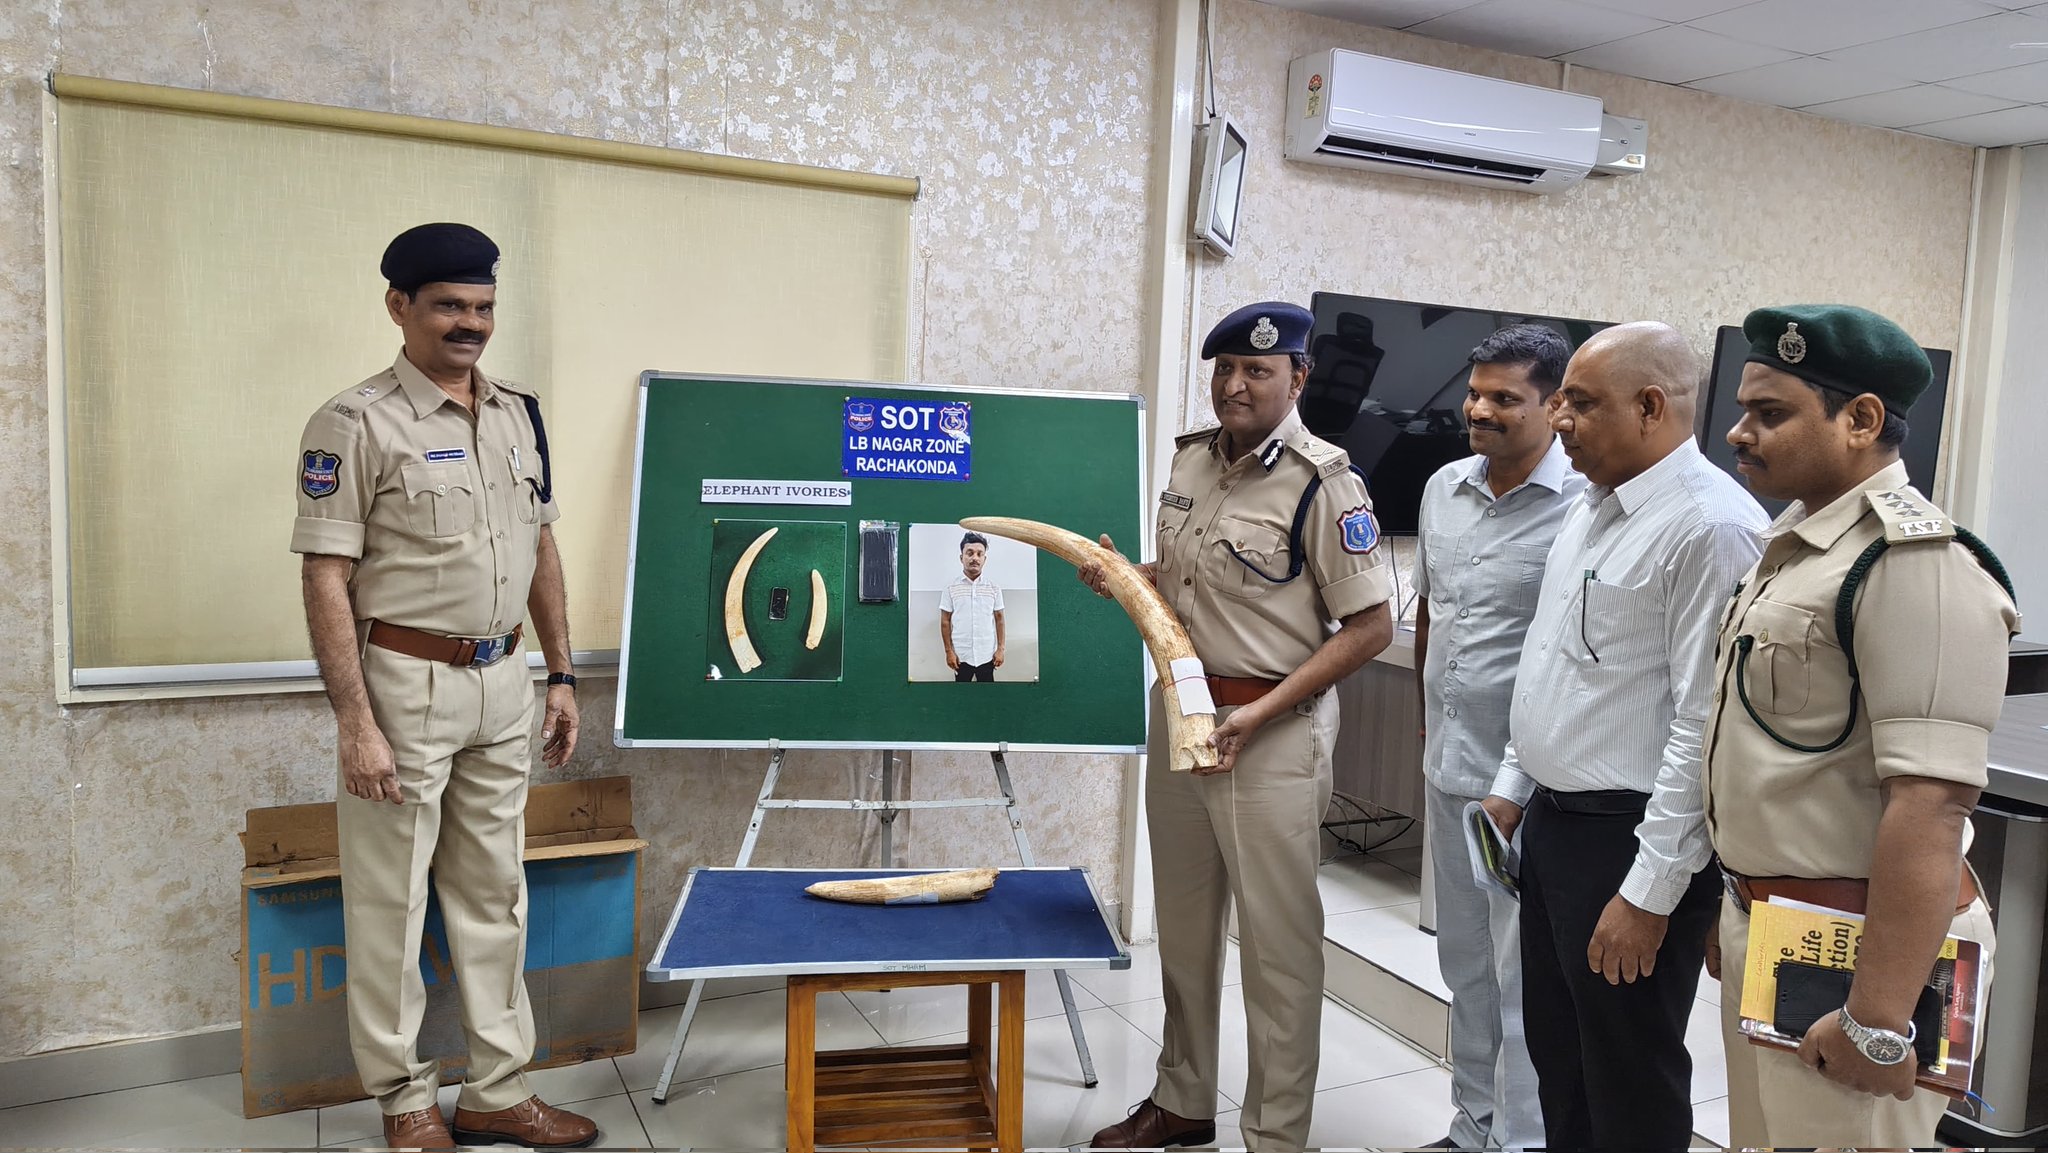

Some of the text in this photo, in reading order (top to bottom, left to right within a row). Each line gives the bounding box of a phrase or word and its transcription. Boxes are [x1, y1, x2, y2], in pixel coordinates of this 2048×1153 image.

[881, 405, 935, 431] SOT
[849, 436, 965, 455] LB NAGAR ZONE
[856, 457, 957, 475] RACHAKONDA
[304, 472, 334, 481] POLICE
[703, 485, 847, 498] ELEPHANT IVORIES
[1800, 930, 1823, 964] Life
